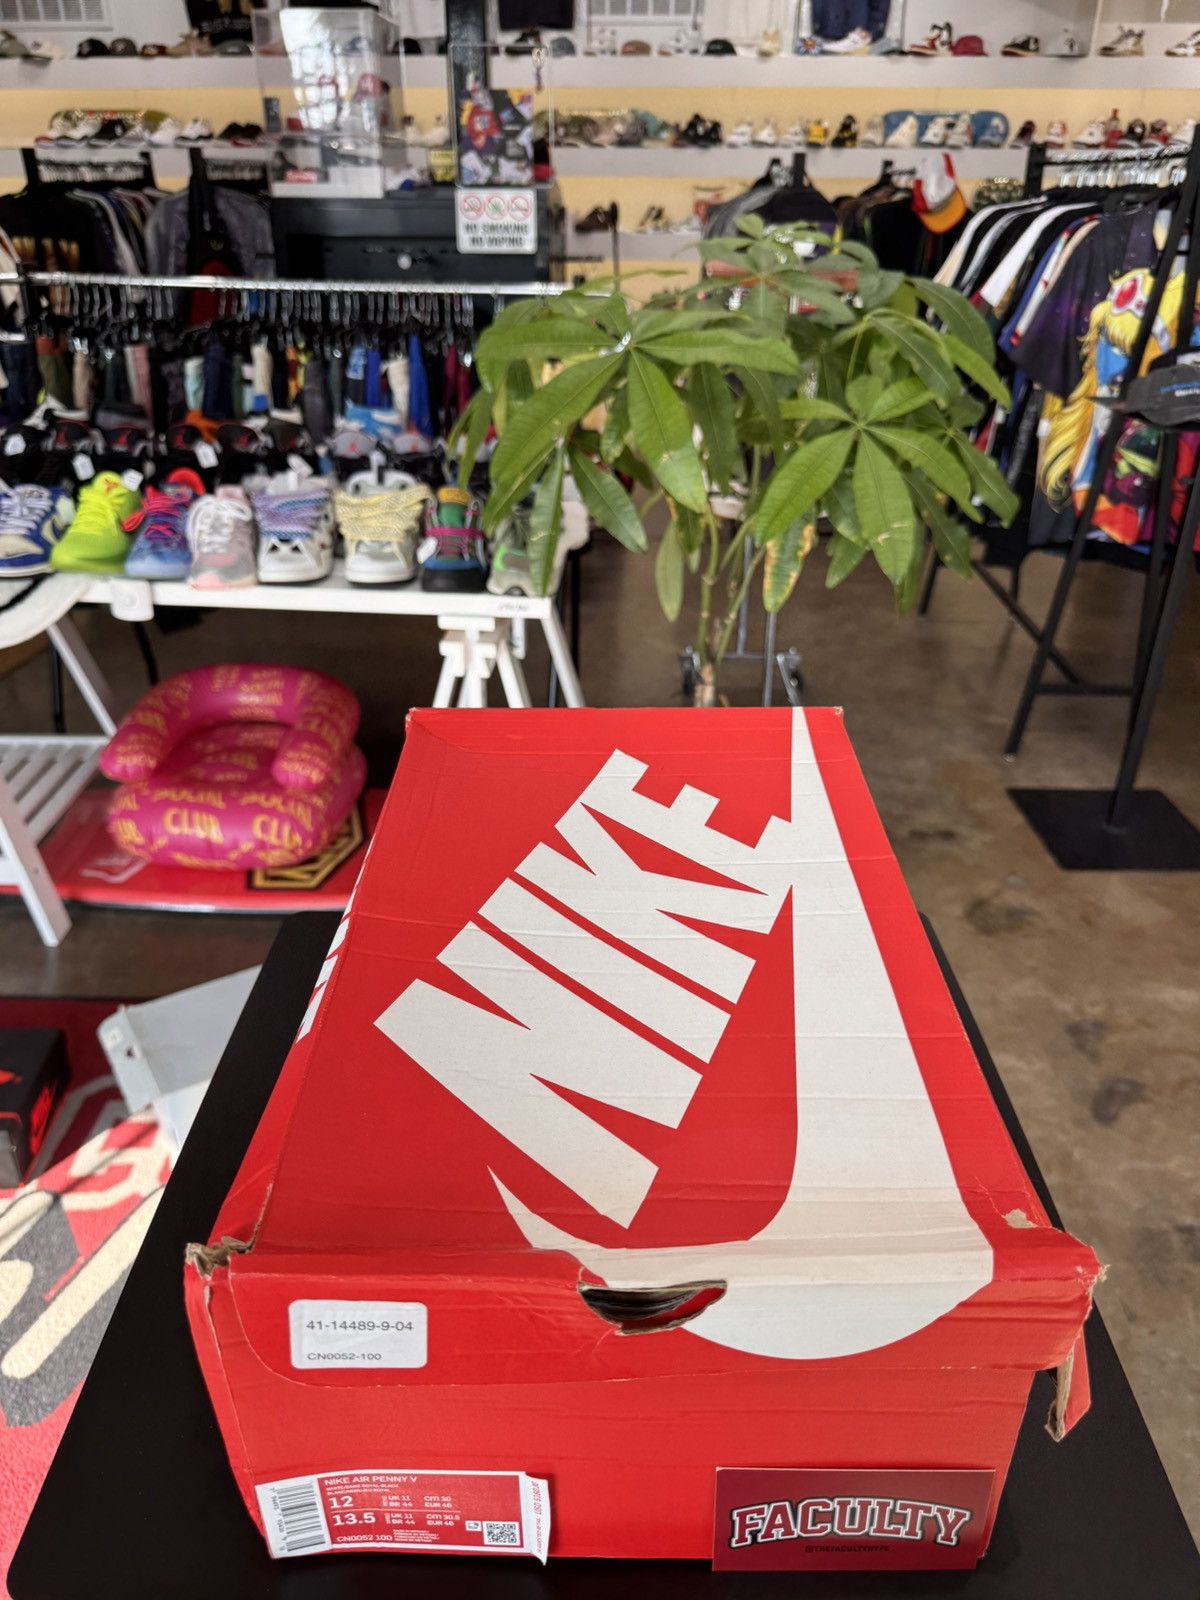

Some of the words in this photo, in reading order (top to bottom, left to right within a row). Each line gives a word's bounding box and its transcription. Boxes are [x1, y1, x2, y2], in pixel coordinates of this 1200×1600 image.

[373, 748, 795, 1229] NIKE
[306, 1320, 414, 1331] 41-14489-9-04
[307, 1352, 382, 1360] CN0052-100
[324, 1477, 350, 1486] NIKE
[372, 1475, 408, 1483] PENNY
[328, 1495, 354, 1508] 12
[332, 1512, 376, 1526] 13.5
[731, 1497, 971, 1548] FACULTY
[336, 1534, 374, 1542] CN0052
